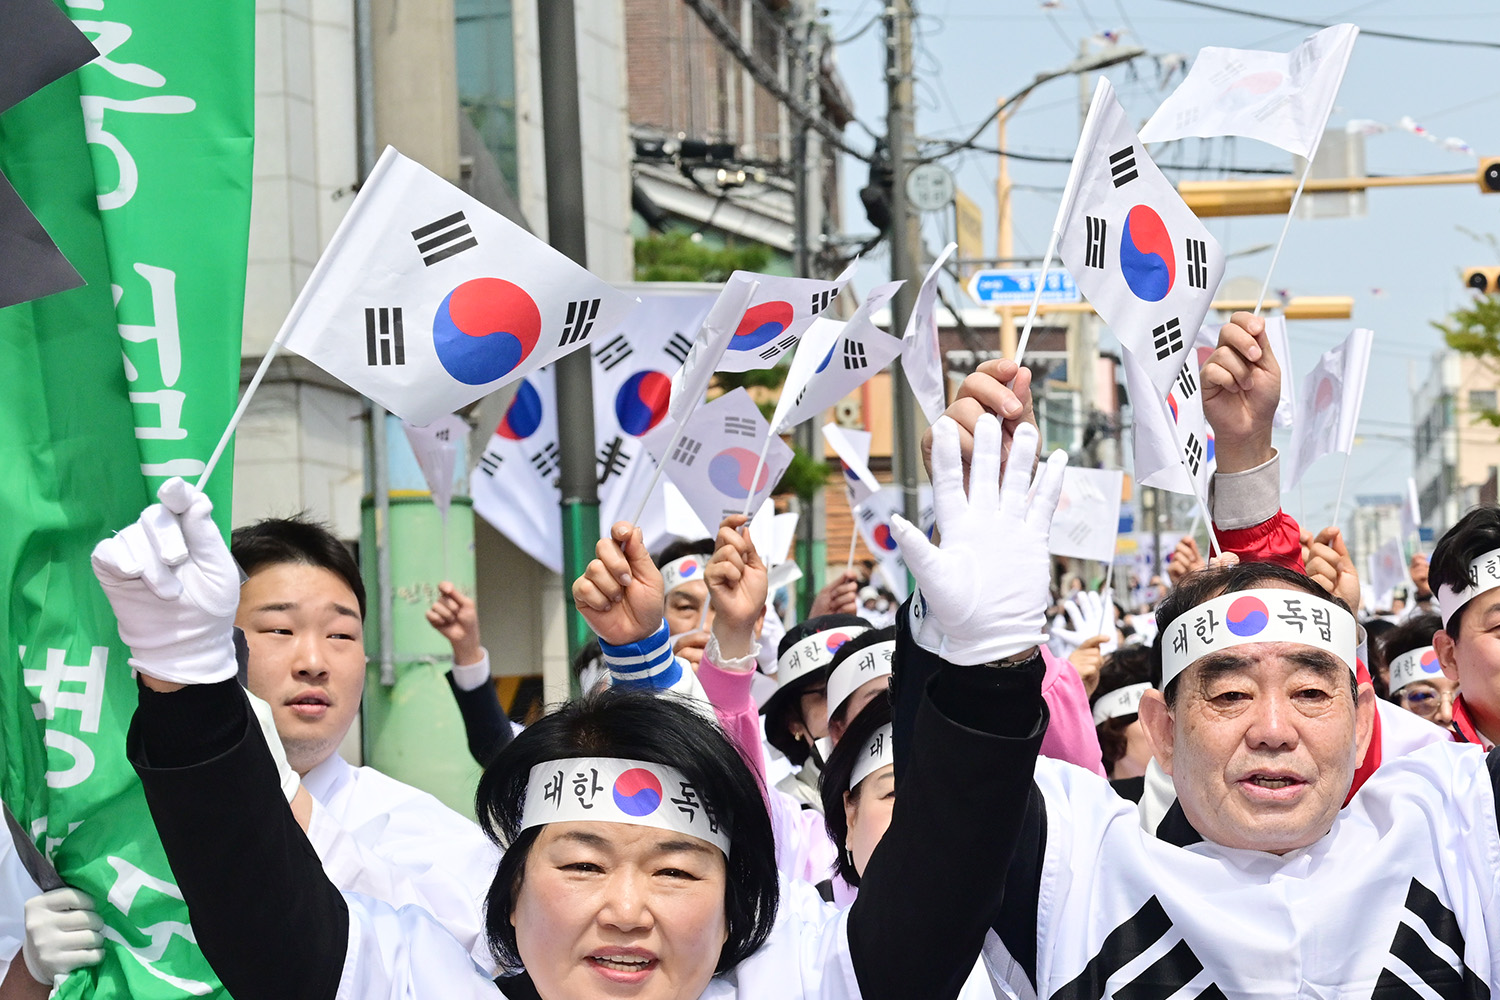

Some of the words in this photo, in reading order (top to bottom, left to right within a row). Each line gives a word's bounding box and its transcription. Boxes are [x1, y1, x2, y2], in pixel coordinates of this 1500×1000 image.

[1172, 609, 1220, 657] 대한
[1277, 599, 1332, 643] 독립
[788, 641, 822, 670] 대한
[543, 768, 604, 812] 대한
